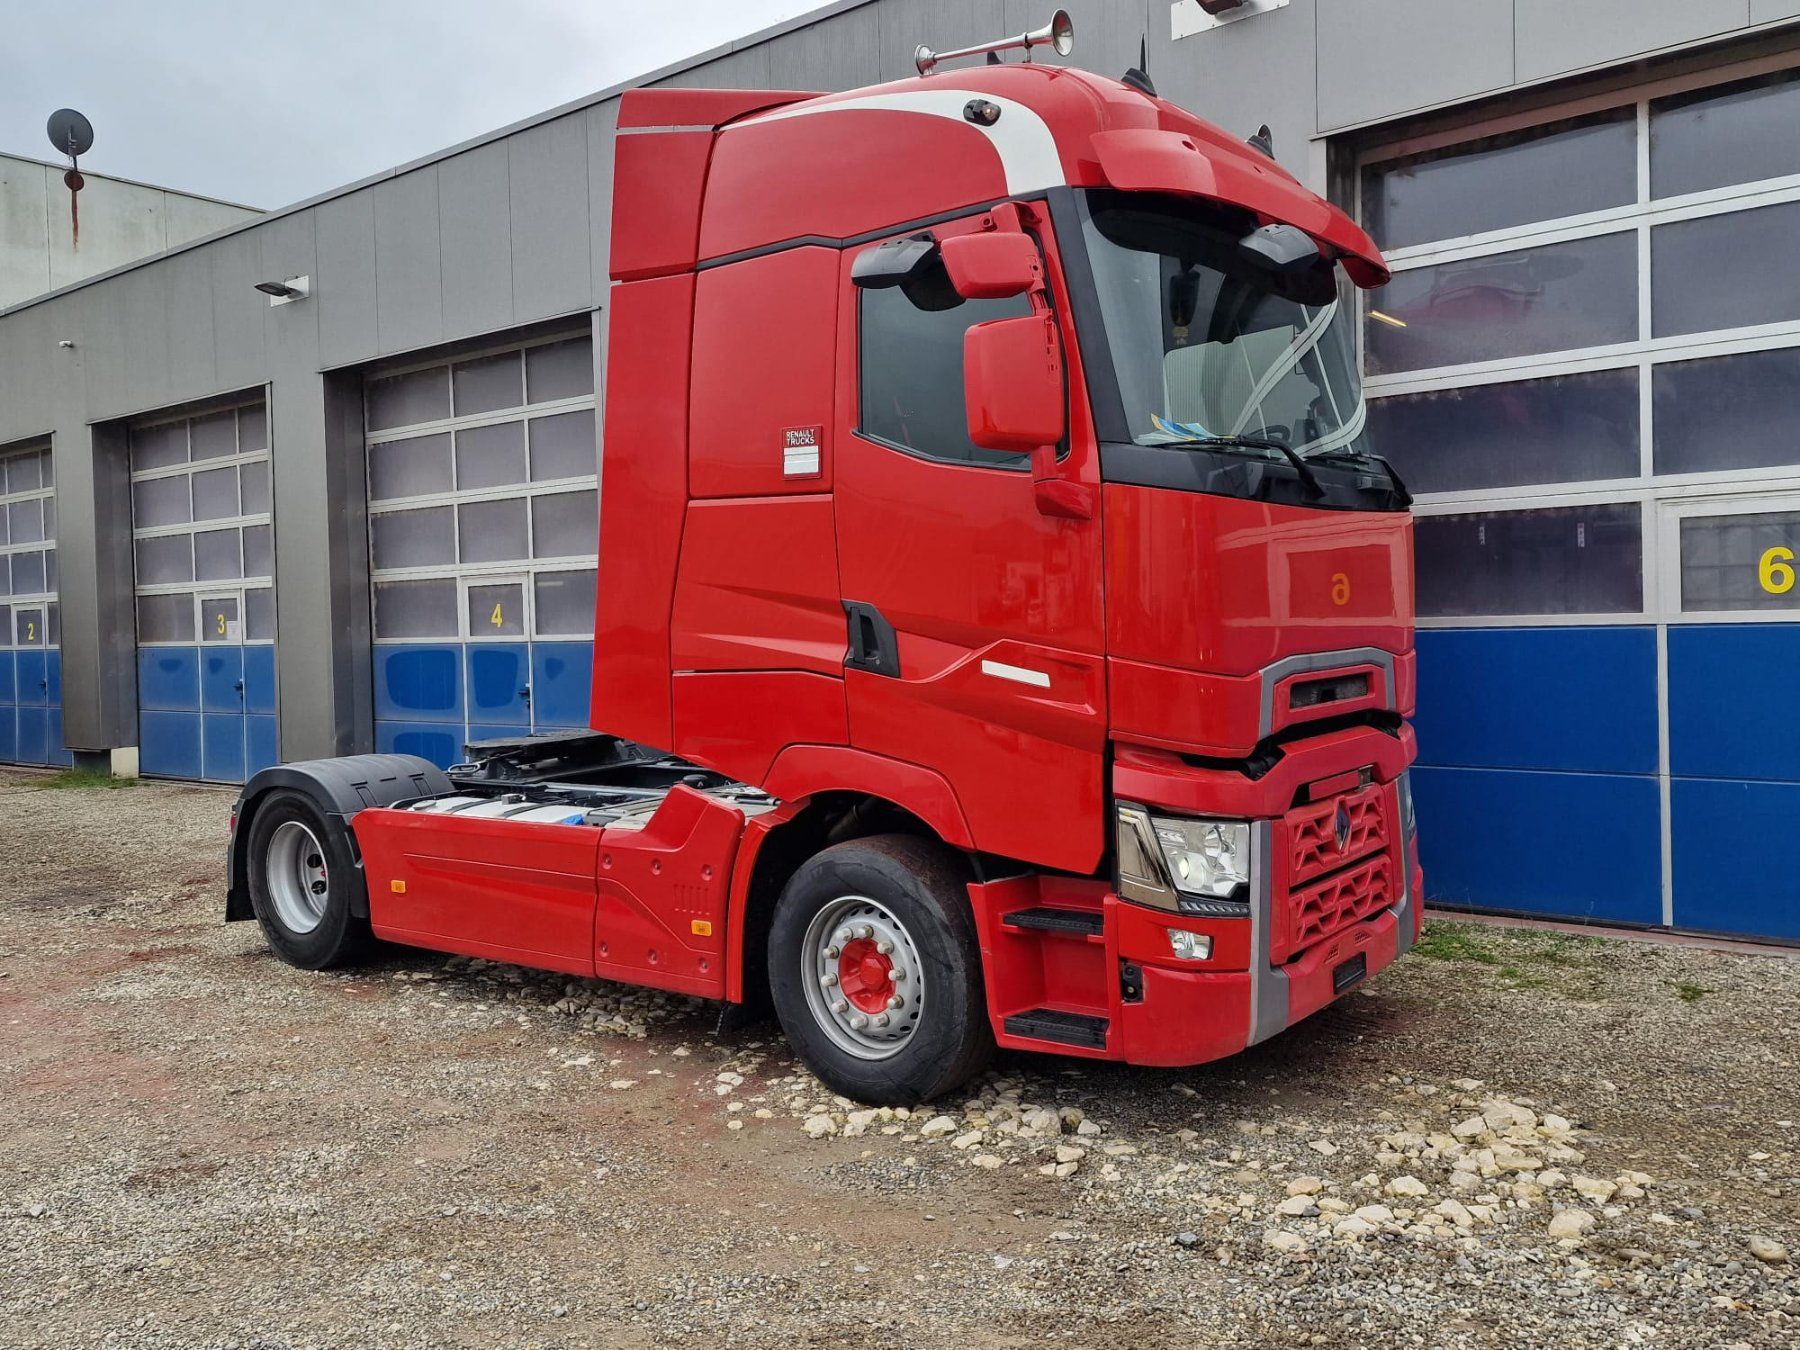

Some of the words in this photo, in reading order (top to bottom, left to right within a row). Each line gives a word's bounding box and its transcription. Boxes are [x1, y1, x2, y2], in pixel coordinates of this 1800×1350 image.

[786, 429, 815, 439] RENAULT
[787, 437, 815, 446] TRUCKS
[1759, 546, 1795, 594] 6
[217, 614, 225, 634] 3
[491, 603, 503, 628] 4
[27, 623, 34, 641] 2
